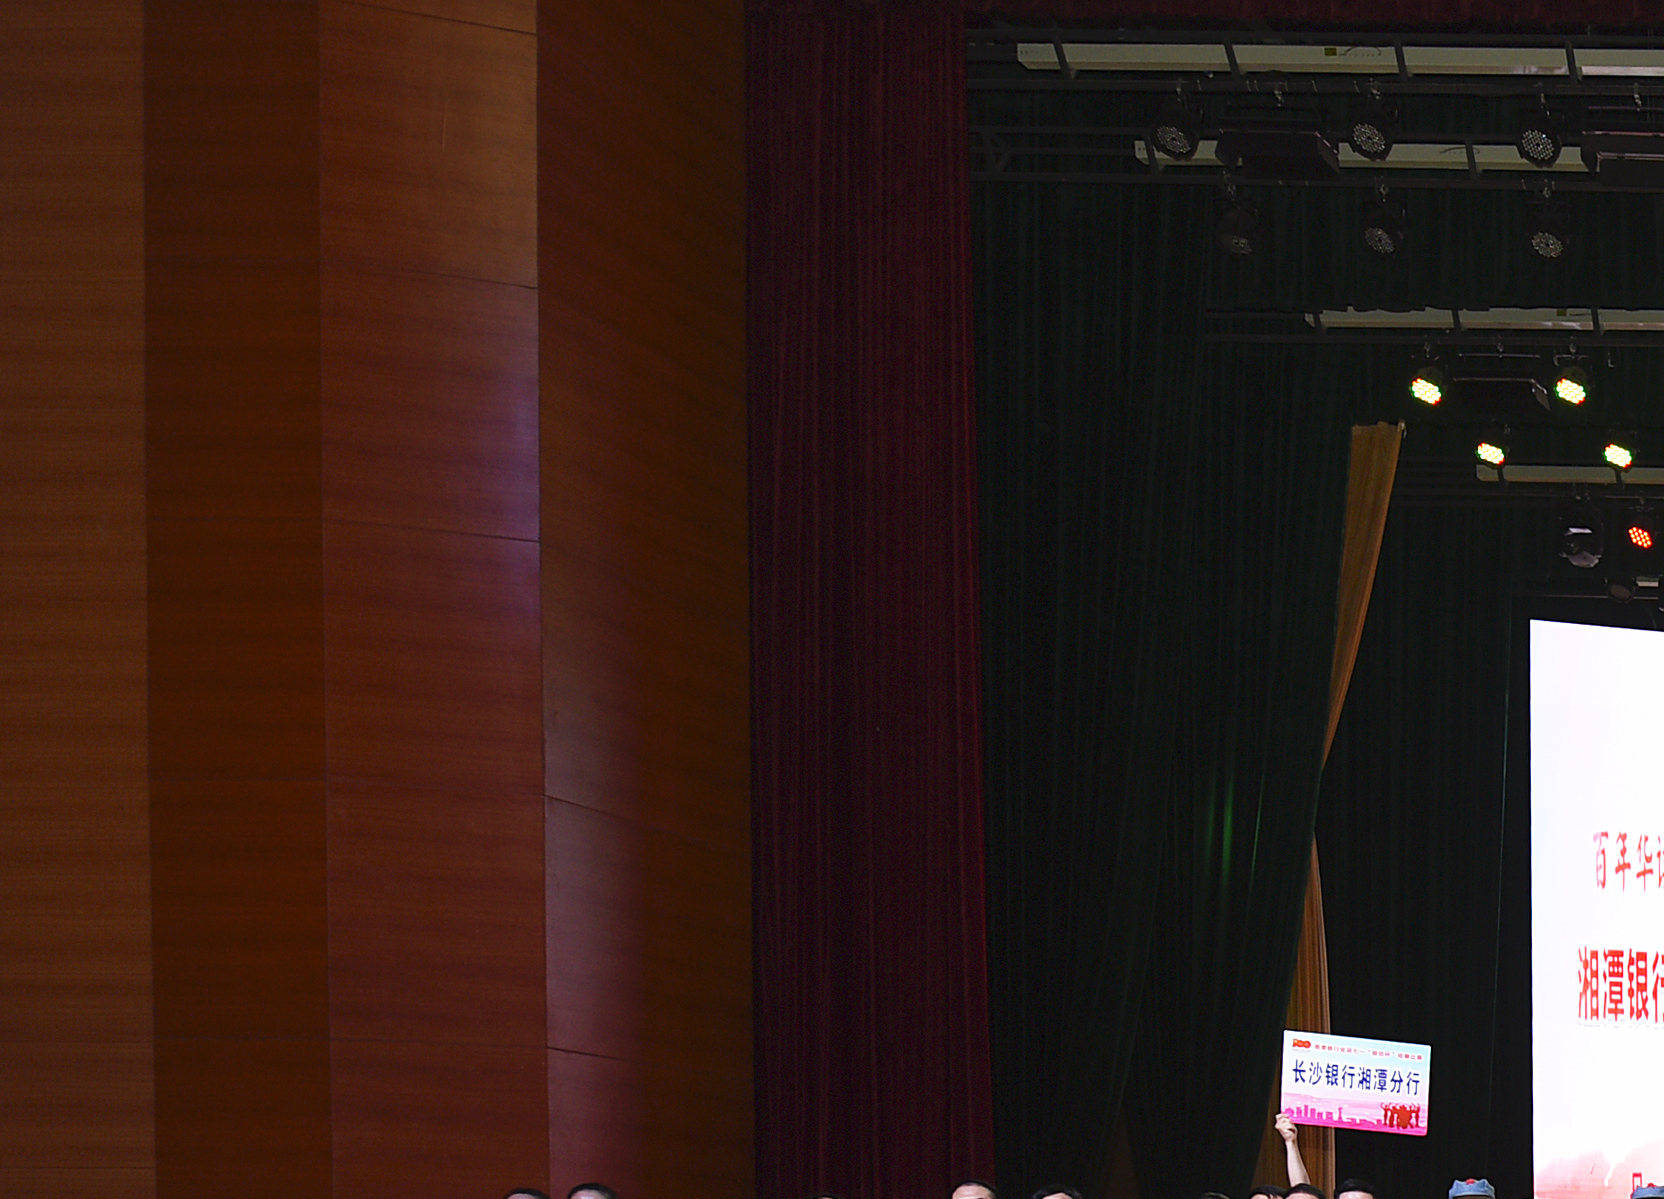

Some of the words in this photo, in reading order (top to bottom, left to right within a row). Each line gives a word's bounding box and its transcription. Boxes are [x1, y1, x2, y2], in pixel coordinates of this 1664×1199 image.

[1292, 1059, 1421, 1096] 长沙银行湘潭分行
